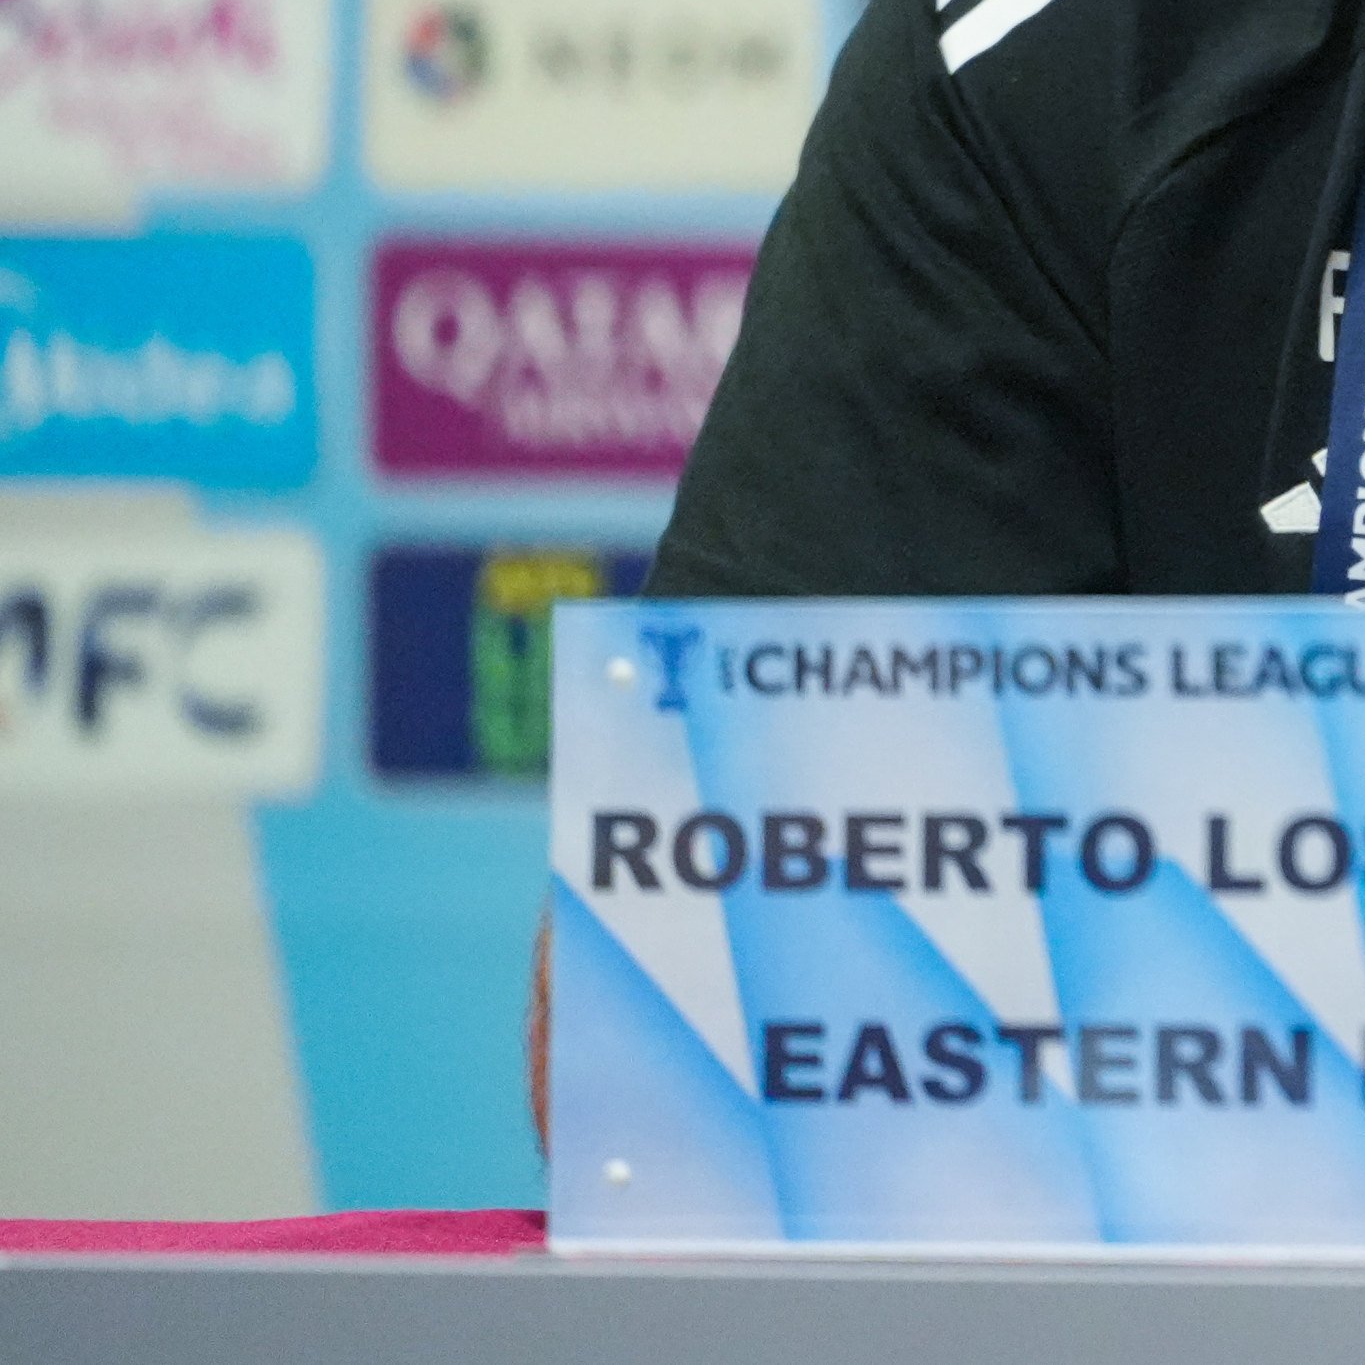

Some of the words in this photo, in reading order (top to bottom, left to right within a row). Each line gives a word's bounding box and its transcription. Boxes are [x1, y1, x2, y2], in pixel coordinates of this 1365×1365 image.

[743, 640, 1152, 699] CHAMPIONS
[590, 809, 1160, 897] ROBERTO
[760, 1017, 1316, 1107] EASTERN
